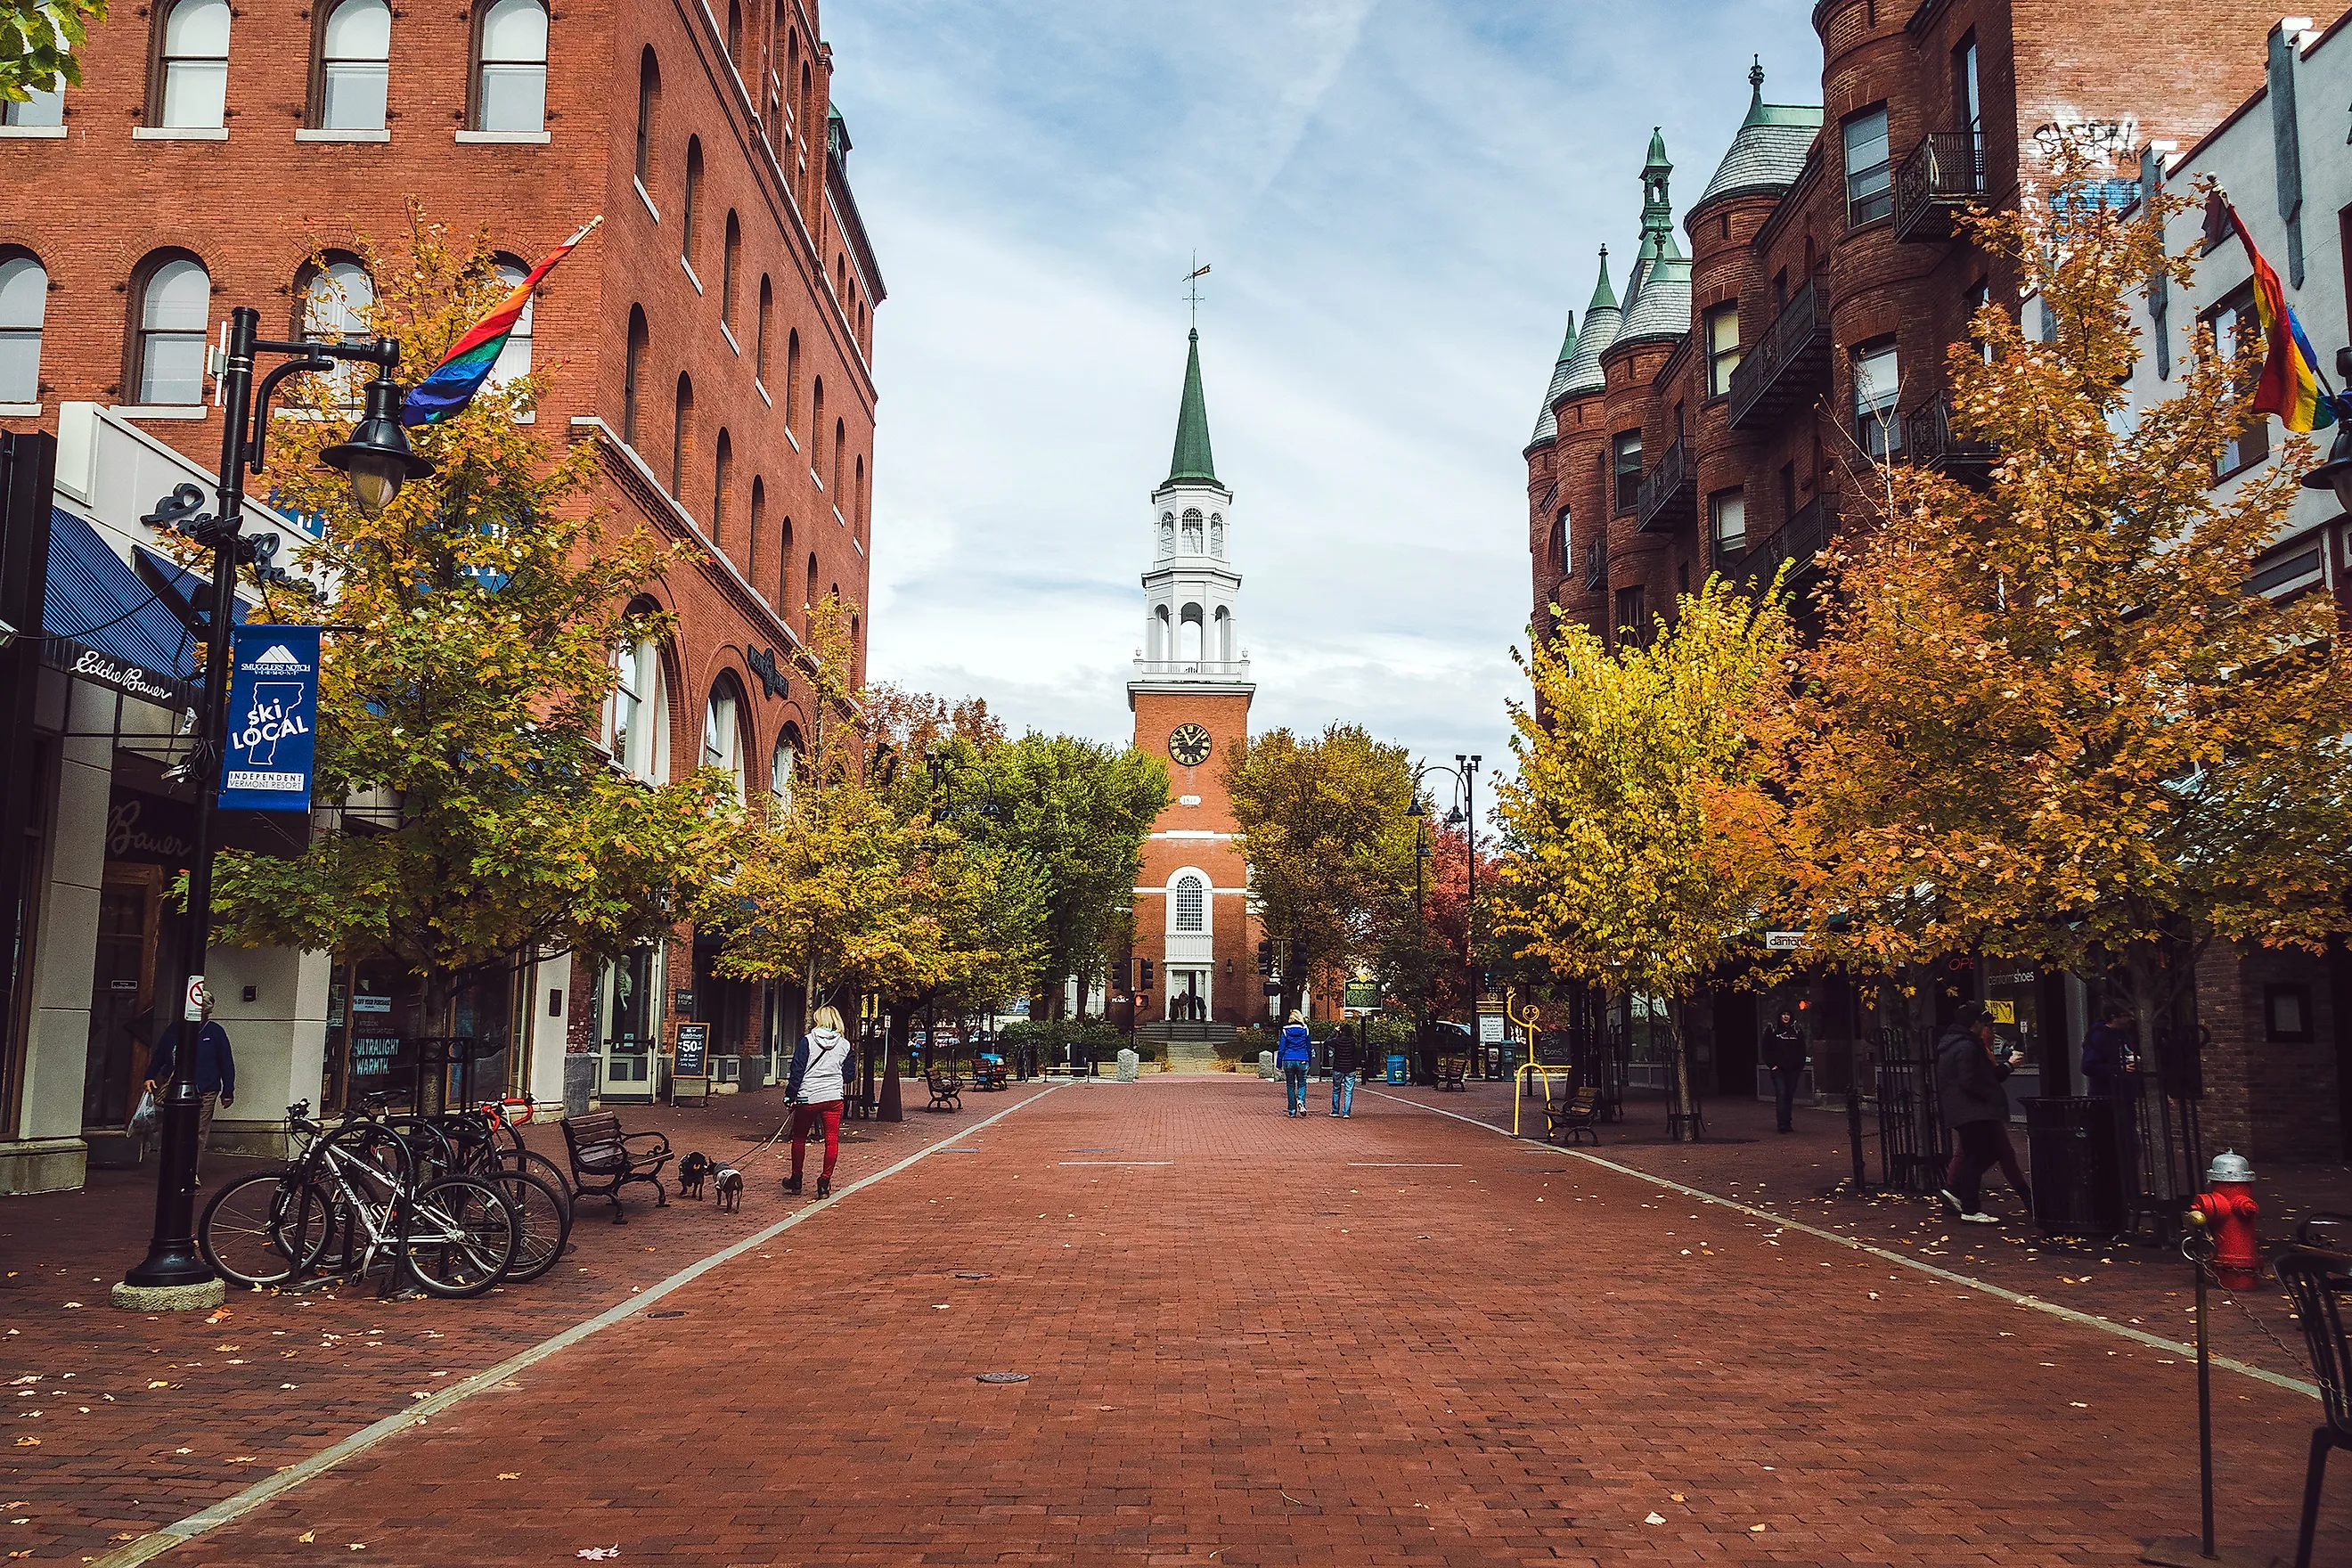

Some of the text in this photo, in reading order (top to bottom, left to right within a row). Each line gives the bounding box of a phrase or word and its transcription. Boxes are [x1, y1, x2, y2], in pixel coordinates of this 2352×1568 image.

[70, 650, 173, 699] Eddie Bauer
[285, 664, 311, 673] NOTCH
[232, 715, 309, 750] LOCAL
[230, 772, 303, 782] INDEPENDENT
[229, 780, 302, 790] VERMONT RESORT
[1948, 958, 1974, 971] OPE
[356, 1038, 400, 1056] ULTRALIGHT
[682, 1040, 698, 1052] 50
